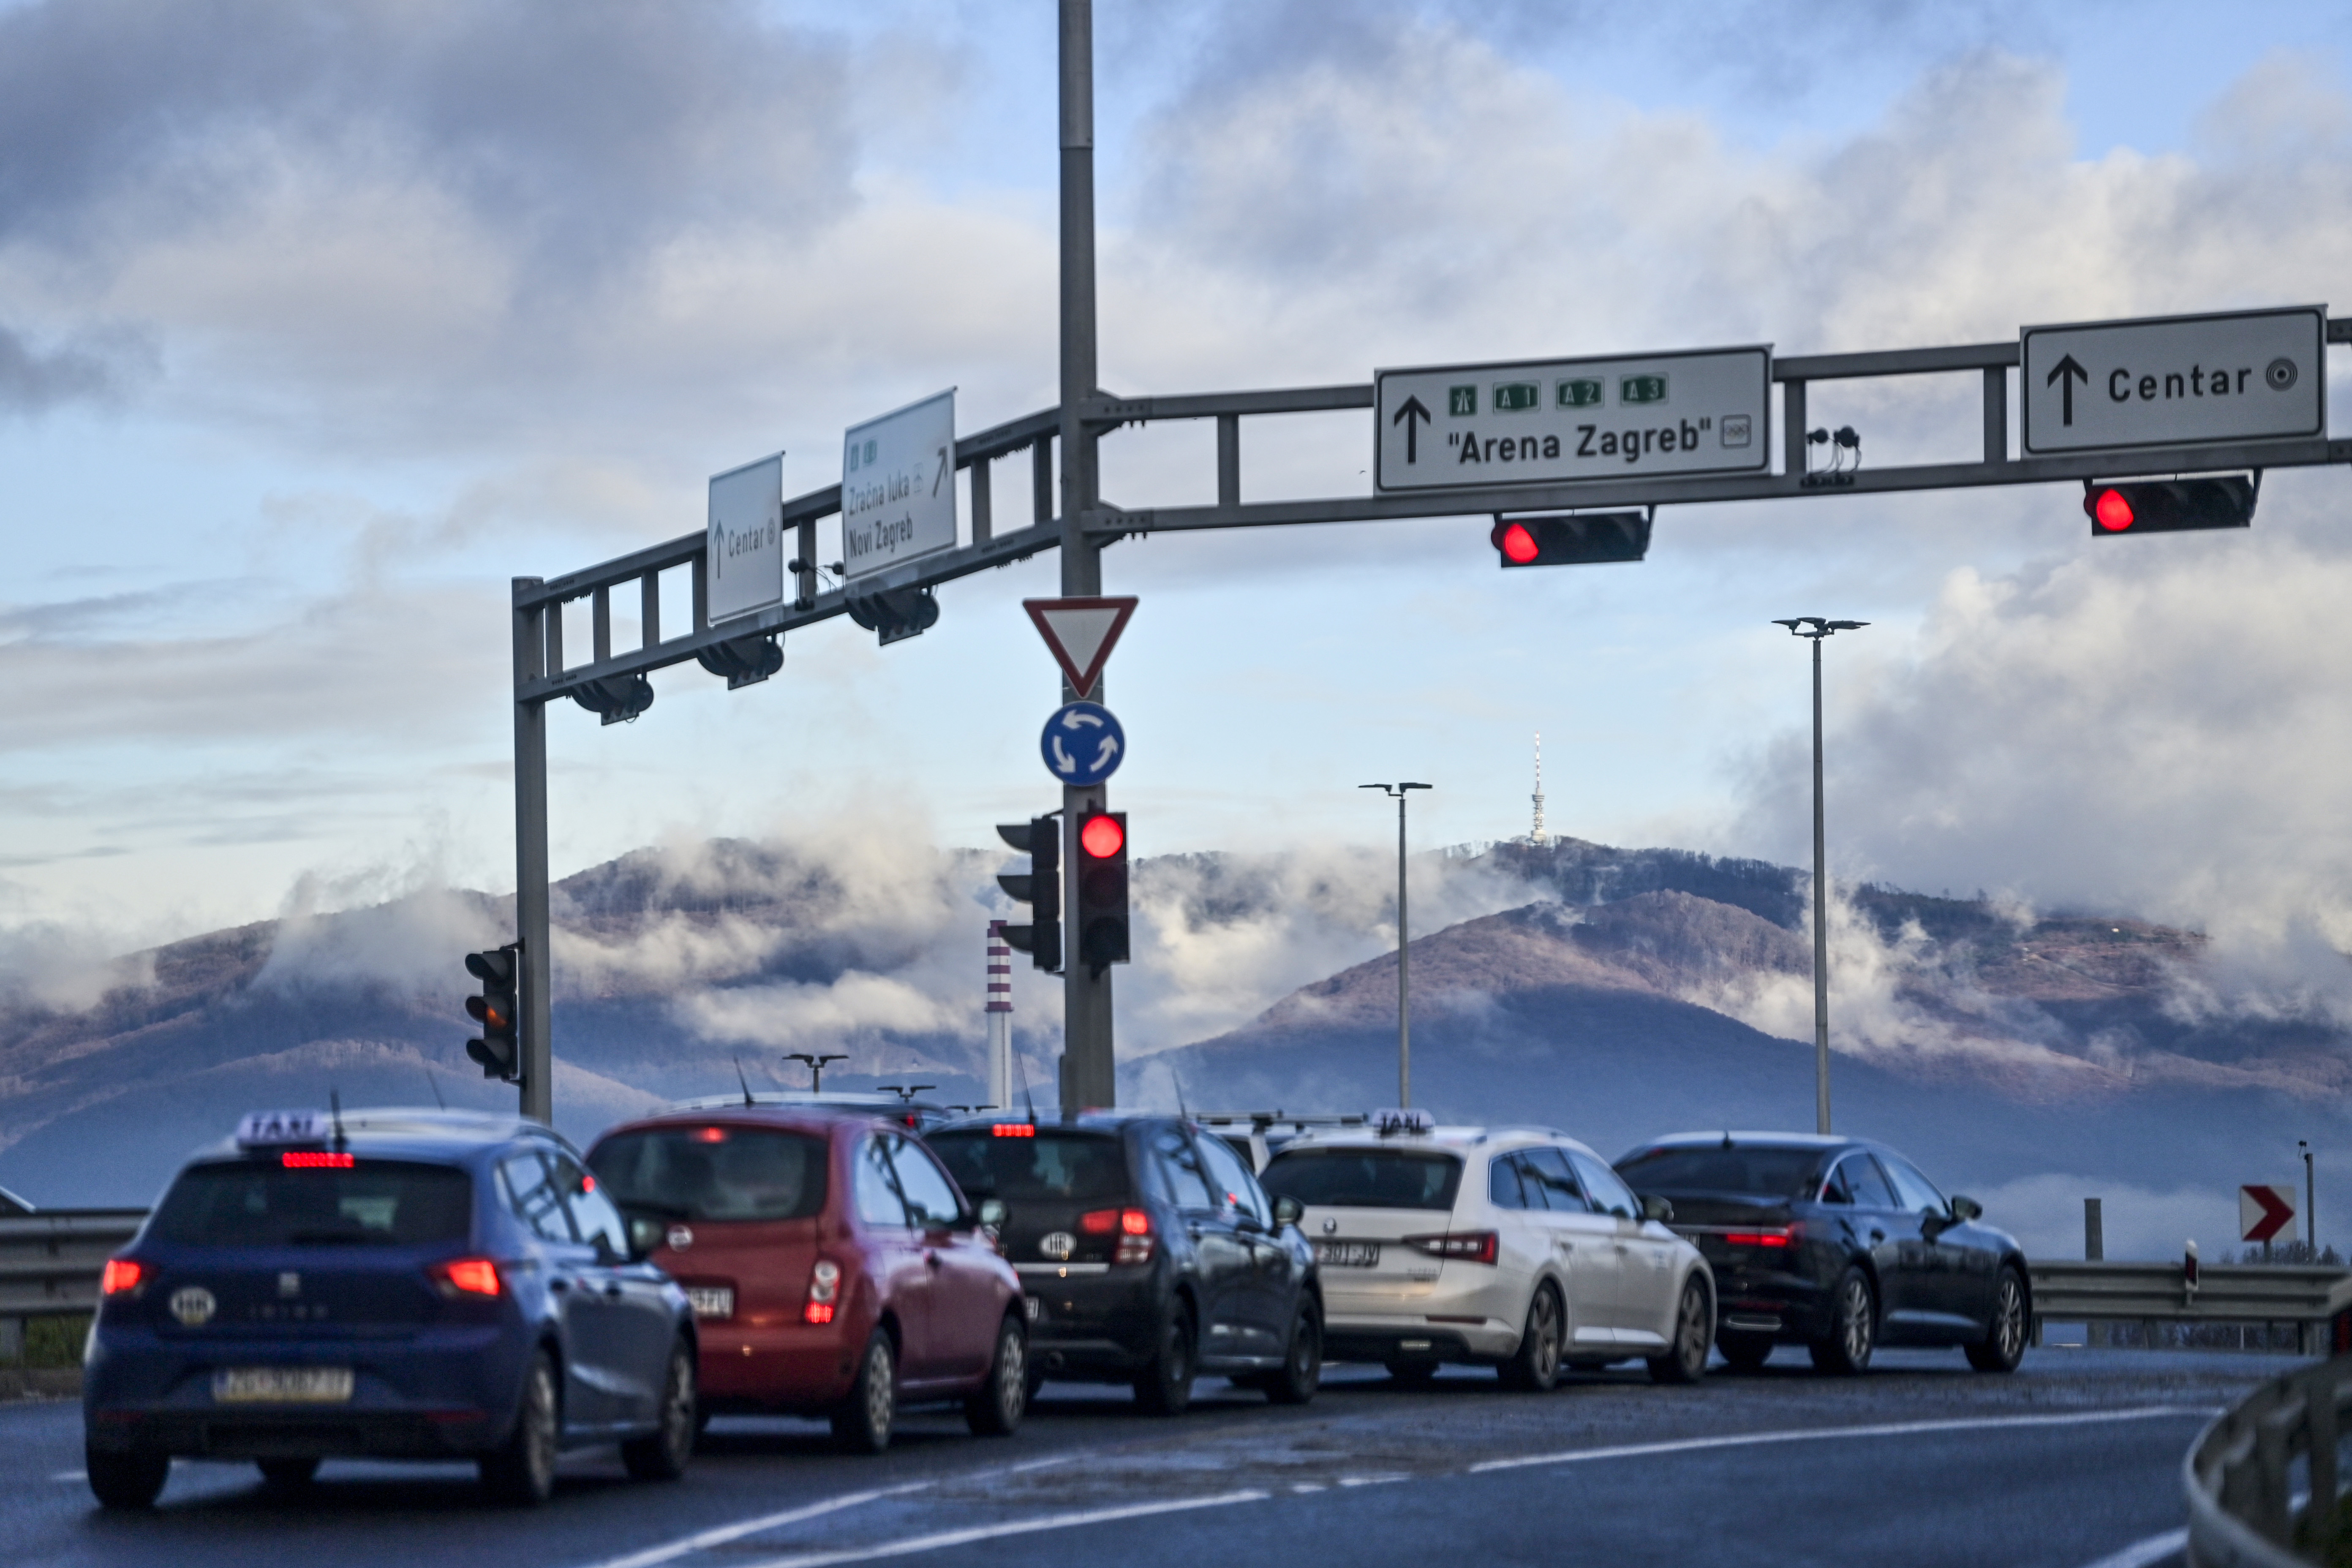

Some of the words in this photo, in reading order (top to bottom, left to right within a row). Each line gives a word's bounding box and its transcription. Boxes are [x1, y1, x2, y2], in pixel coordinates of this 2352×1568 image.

[2109, 364, 2252, 402] Centar
[1449, 430, 1561, 463] "Arena
[1577, 417, 1712, 463] Zagreb"
[888, 469, 909, 502] luka
[729, 524, 764, 558] Centar
[849, 523, 872, 558] Novi
[875, 511, 913, 553] Zagreb
[252, 1116, 313, 1137] TAXI
[1380, 1111, 1420, 1130] TAXI
